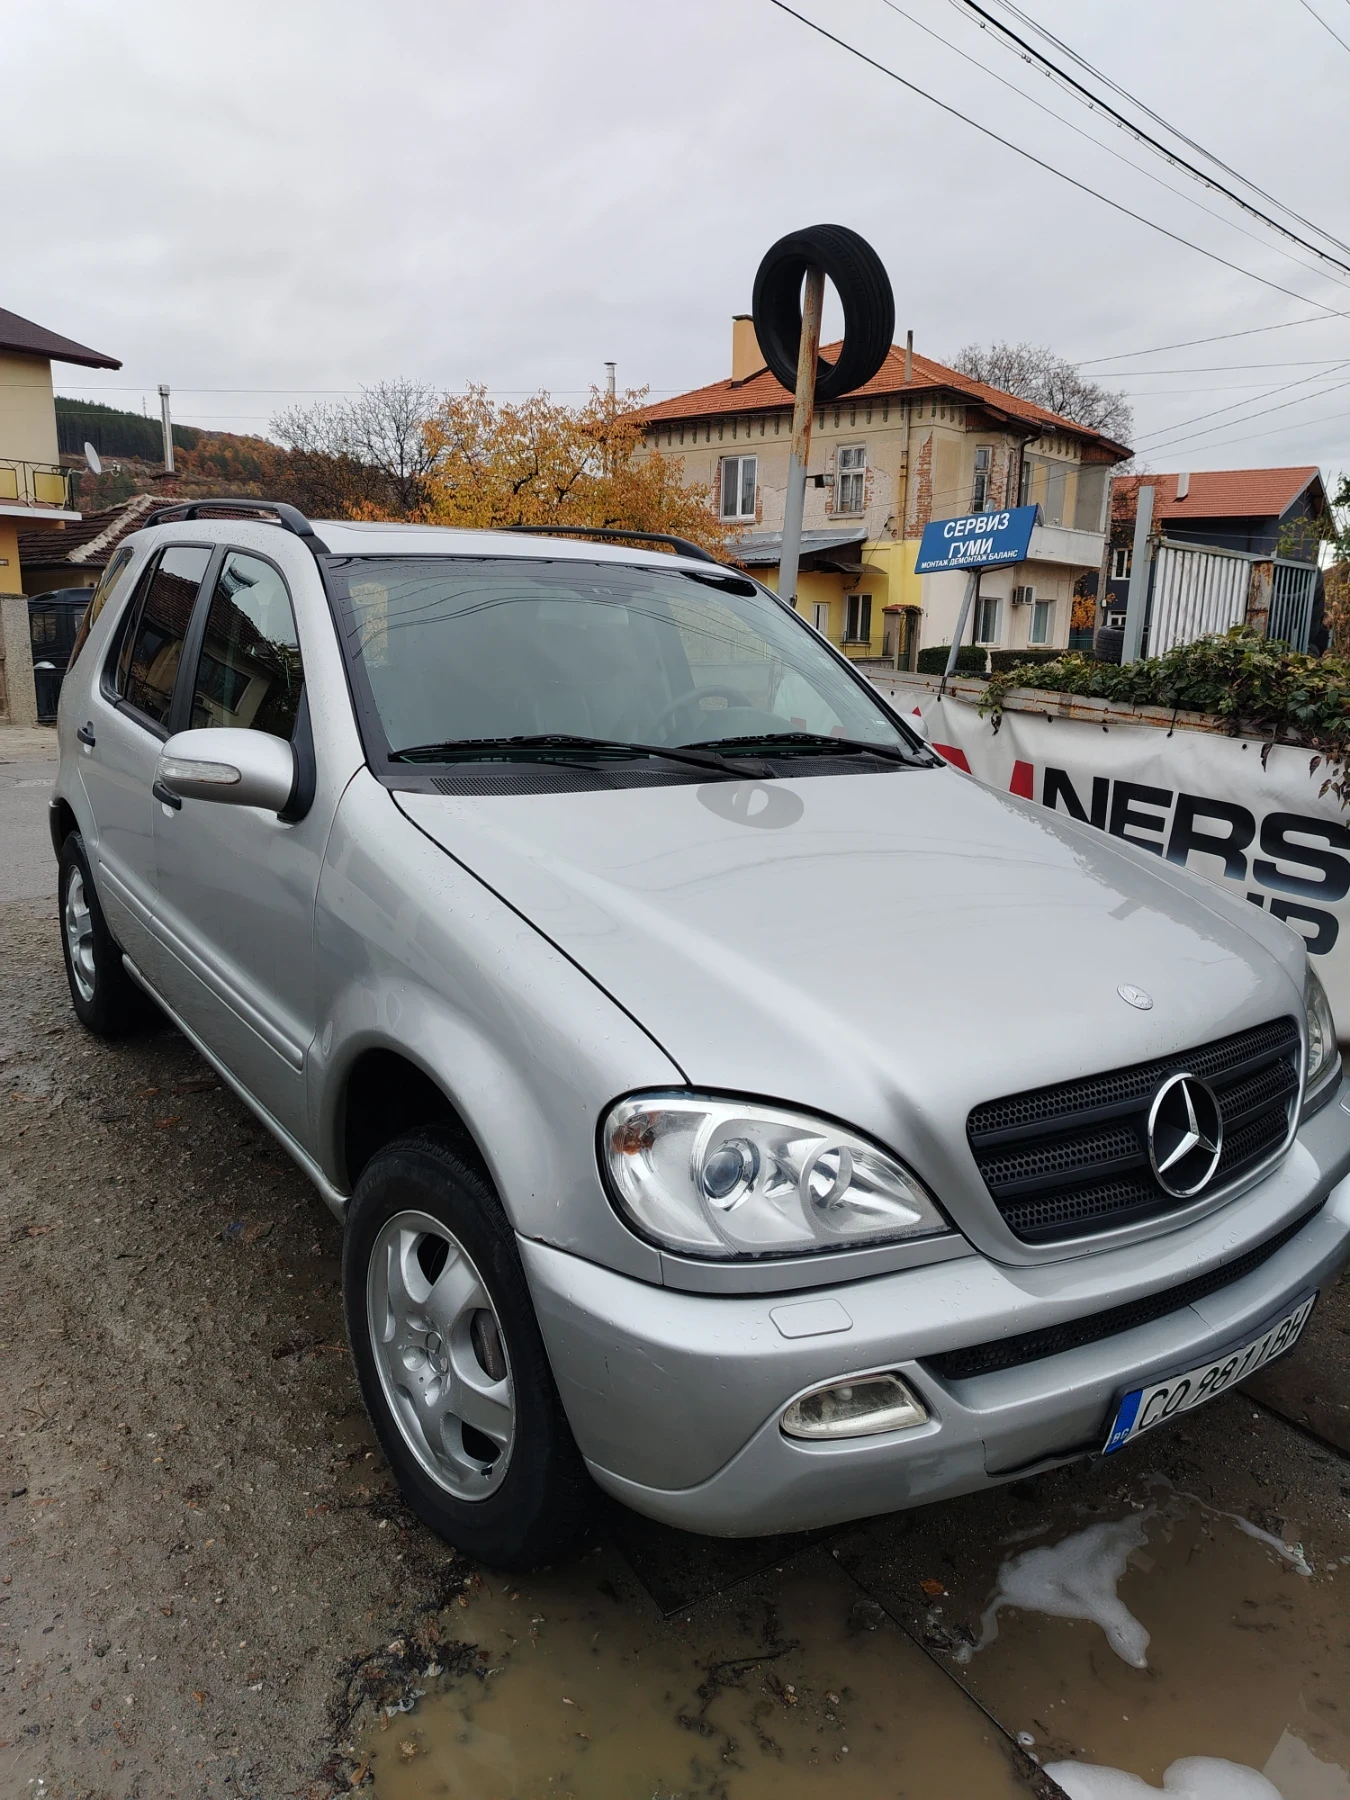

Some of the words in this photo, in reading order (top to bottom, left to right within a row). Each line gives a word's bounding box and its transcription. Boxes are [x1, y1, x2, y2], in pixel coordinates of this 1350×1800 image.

[943, 512, 1010, 538] СЕРВИЗ
[948, 537, 994, 558] ГУМИ
[921, 559, 950, 569] МОНТАЖ
[949, 553, 987, 567] ДЕМОНТАЖ
[988, 549, 1019, 561] БАЛАНС
[1138, 1378, 1191, 1430] CO
[1188, 1333, 1273, 1405] 9811
[1265, 1302, 1311, 1361] BH
[1111, 1427, 1130, 1445] BG
